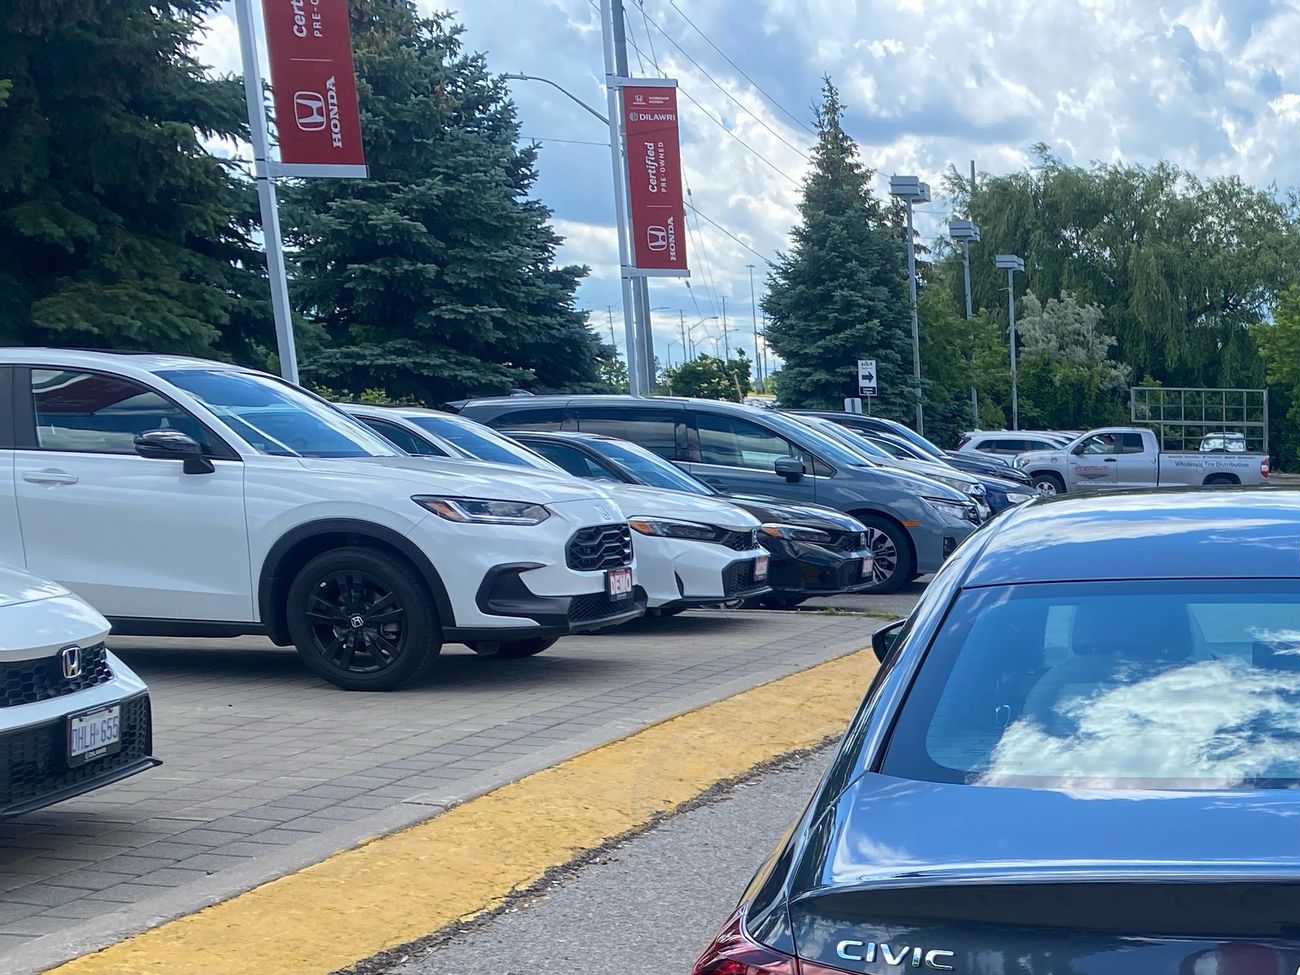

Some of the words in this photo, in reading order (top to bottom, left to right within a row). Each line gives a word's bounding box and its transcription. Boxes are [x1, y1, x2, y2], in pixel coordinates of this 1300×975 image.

[326, 75, 342, 149] HONDA
[639, 113, 676, 121] DILAWRI
[644, 142, 658, 193] Certified
[657, 141, 667, 193] PRE-OWNED
[667, 216, 677, 261] HONDA
[610, 573, 632, 596] DEMO
[836, 939, 955, 971] CIVIC
